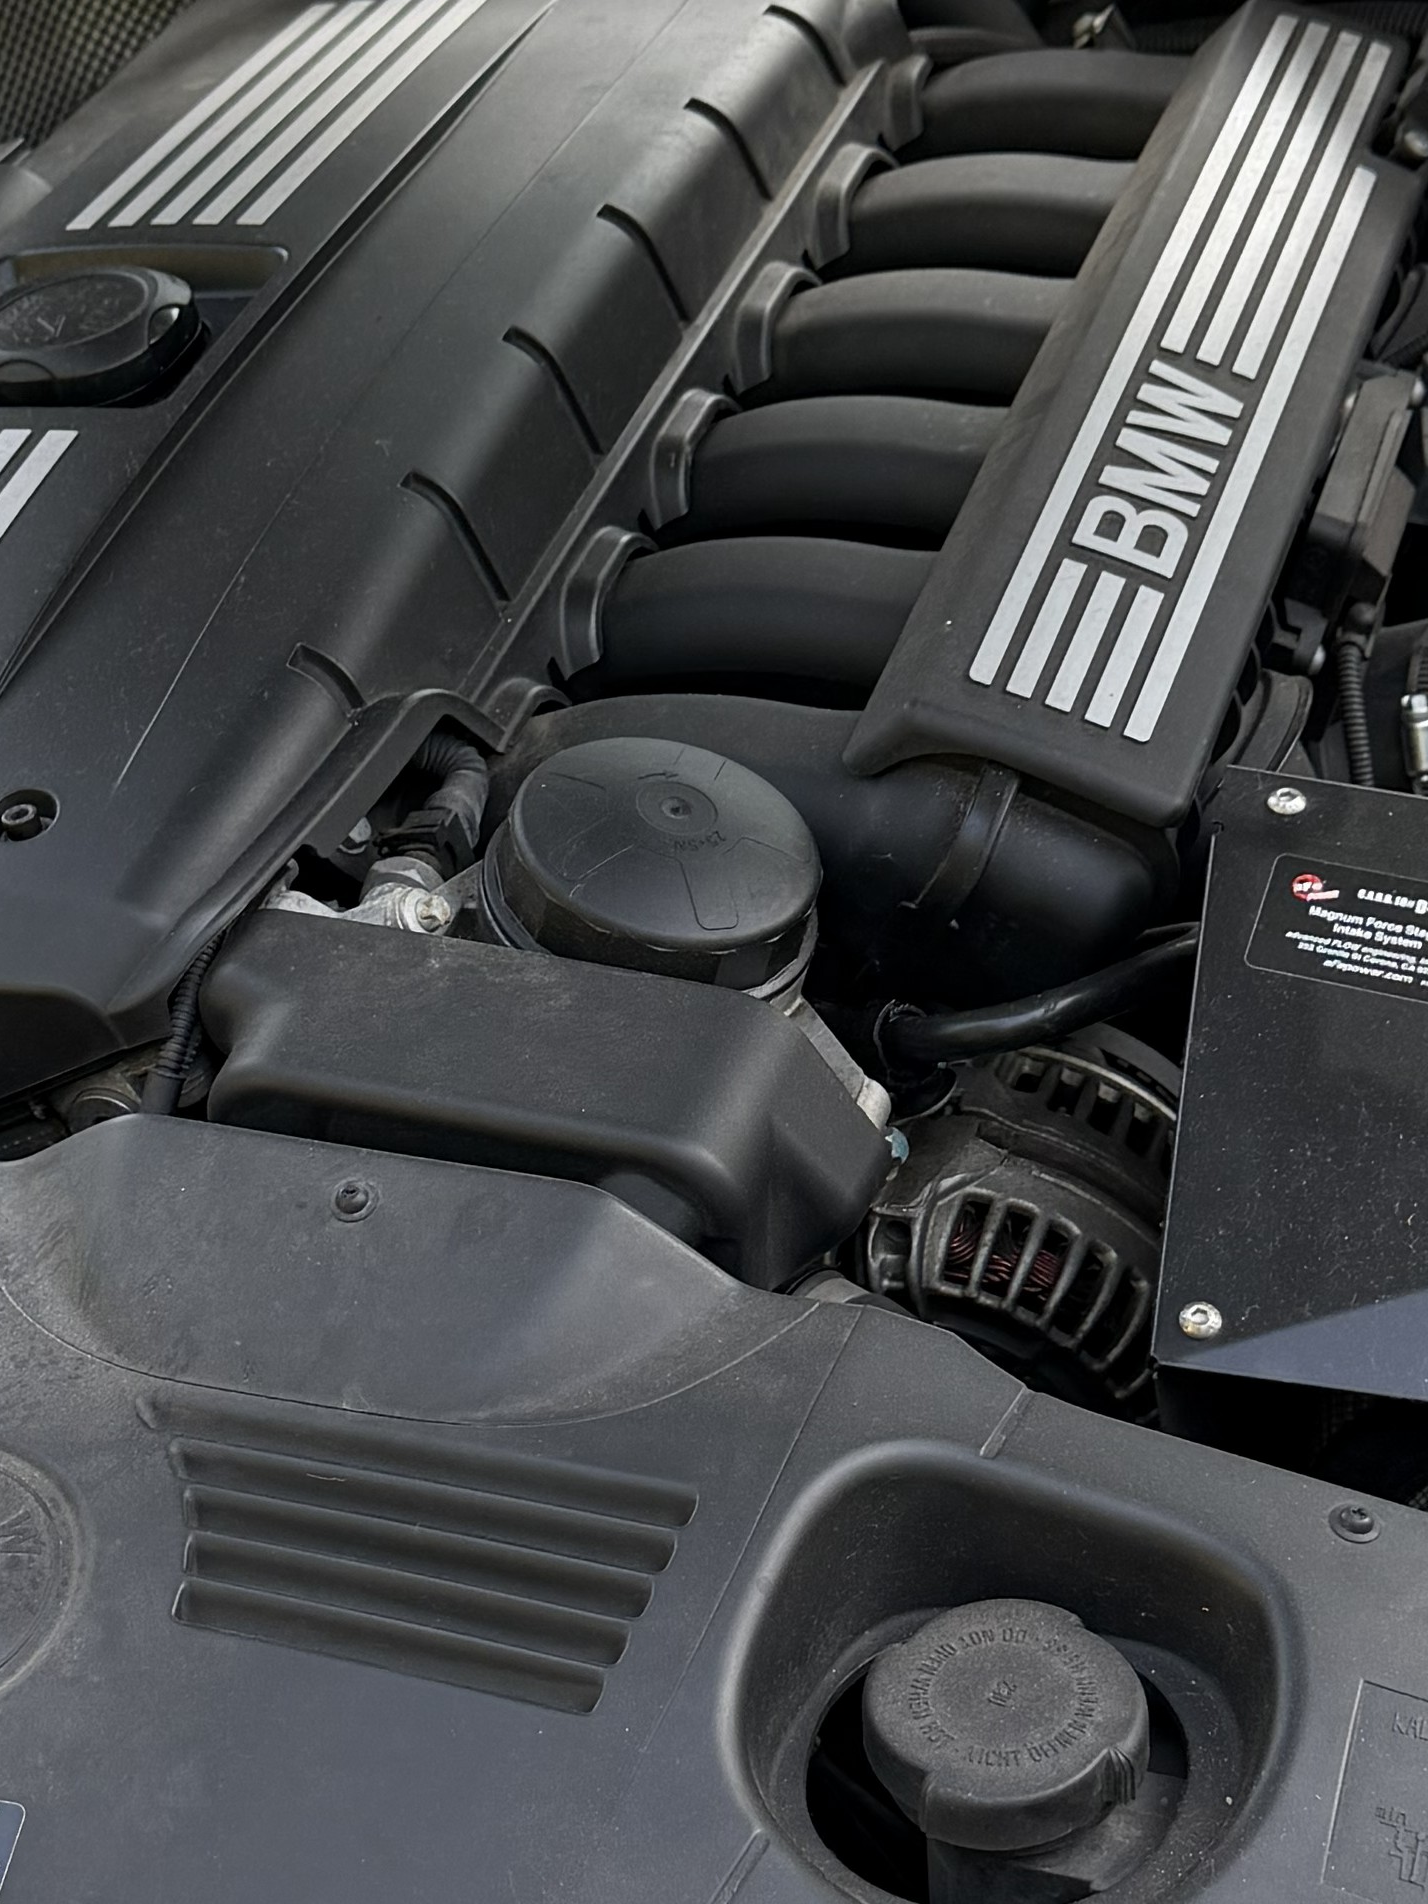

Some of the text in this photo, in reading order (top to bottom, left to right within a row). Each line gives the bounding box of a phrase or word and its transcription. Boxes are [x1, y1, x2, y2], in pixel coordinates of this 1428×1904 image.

[1072, 360, 1244, 579] BMW
[1308, 905, 1364, 926] Magnum
[1366, 916, 1403, 933] Force
[1332, 922, 1423, 950] Intake System
